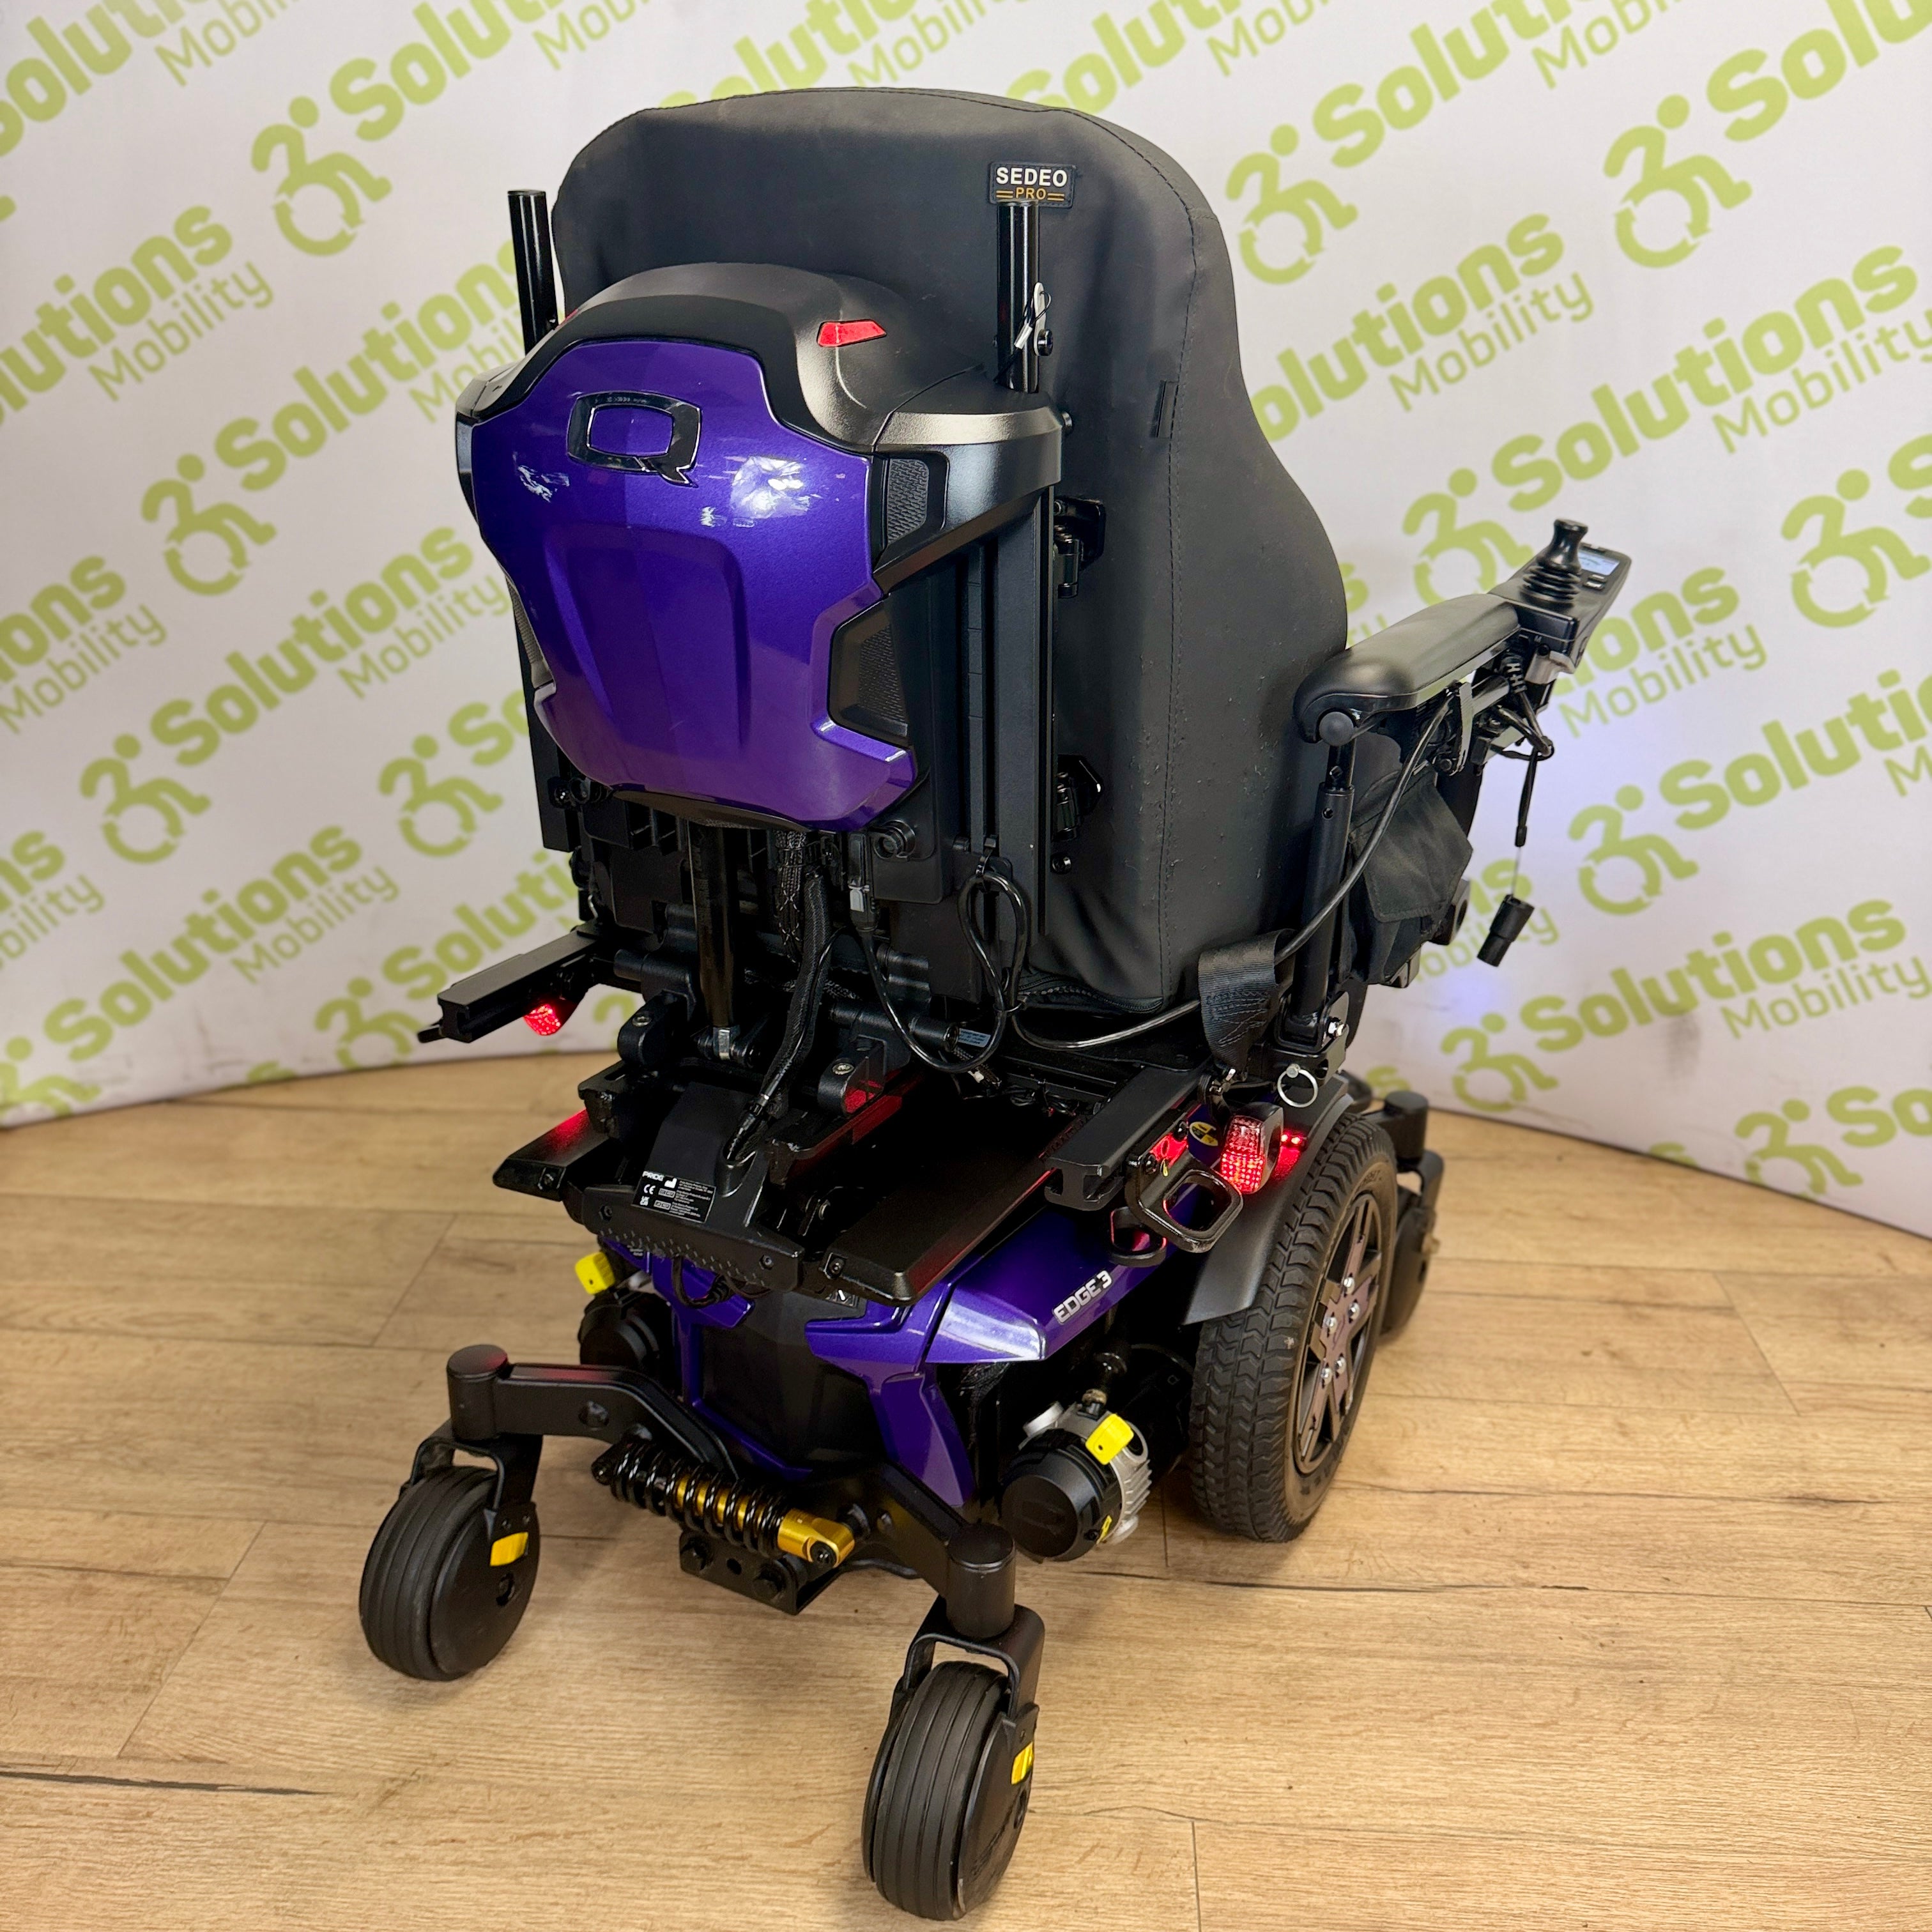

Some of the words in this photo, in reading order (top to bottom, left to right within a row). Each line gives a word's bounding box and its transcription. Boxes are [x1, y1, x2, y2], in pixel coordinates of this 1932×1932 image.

[995, 166, 1068, 187] SEDEO
[1015, 187, 1046, 200] PRO
[88, 261, 274, 401] Mobility
[214, 238, 519, 493] Solution
[1388, 272, 1595, 413] Mobility
[1491, 245, 1919, 512] Solutions
[149, 526, 475, 767] Solutions
[337, 576, 513, 698] Mobility
[1558, 624, 1768, 739] Mobility
[42, 825, 362, 1061] Solutions
[230, 866, 401, 984] Mobility
[1519, 899, 1907, 1053] Solutions
[1720, 956, 1932, 1039] Mobility
[1053, 1278, 1101, 1323] EDGE
